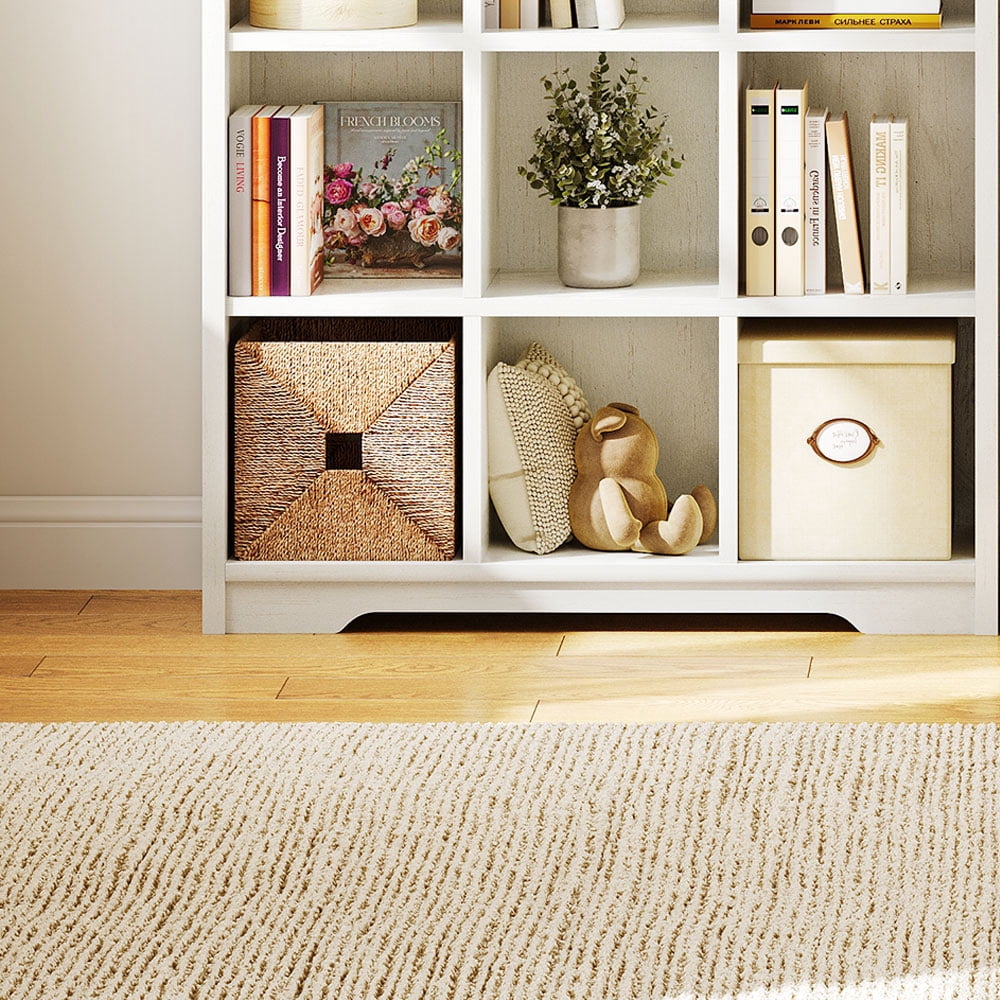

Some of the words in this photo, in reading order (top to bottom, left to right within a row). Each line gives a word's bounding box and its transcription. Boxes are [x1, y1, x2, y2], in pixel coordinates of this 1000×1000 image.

[879, 18, 912, 26] СТРАХА
[340, 115, 387, 127] FRENCH
[390, 115, 441, 127] BLOOMS
[235, 161, 245, 193] LIVING
[277, 156, 287, 187] Become
[278, 187, 284, 197] an
[277, 198, 287, 227] Interior
[274, 227, 287, 263] Designer
